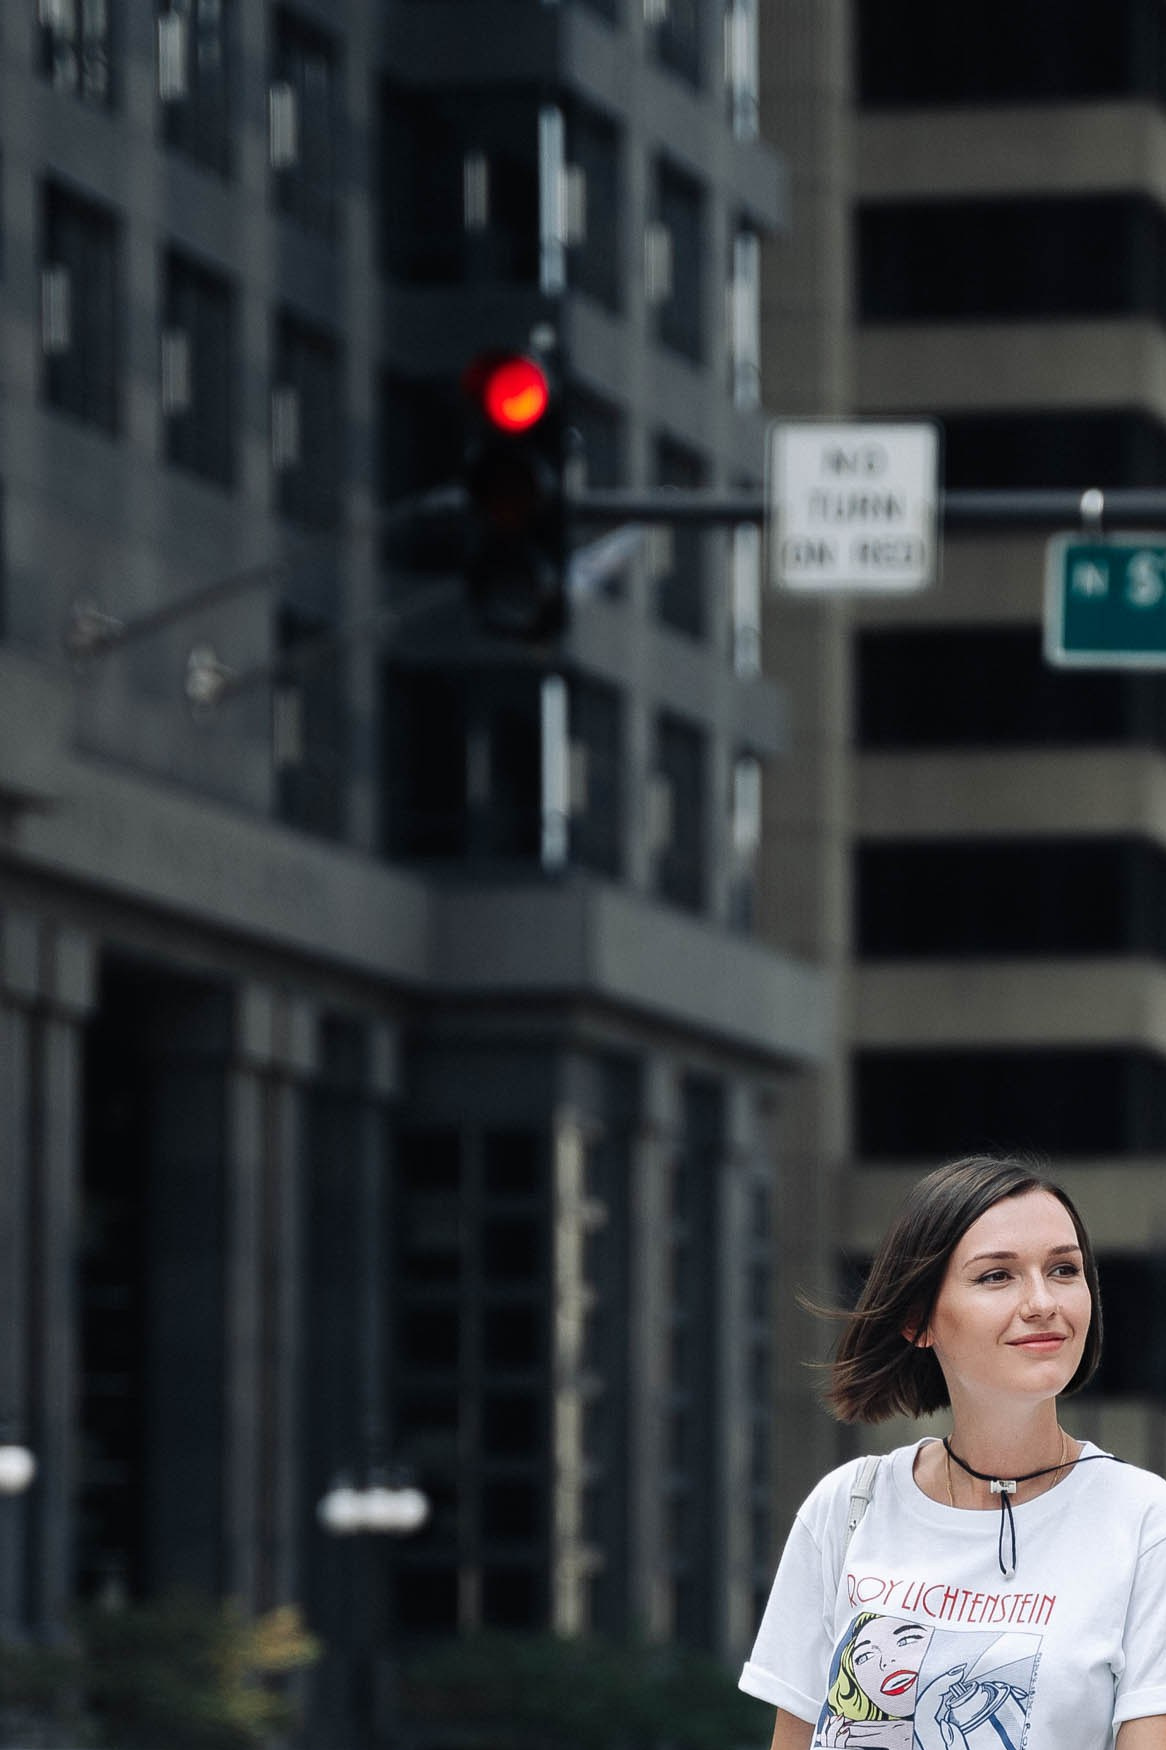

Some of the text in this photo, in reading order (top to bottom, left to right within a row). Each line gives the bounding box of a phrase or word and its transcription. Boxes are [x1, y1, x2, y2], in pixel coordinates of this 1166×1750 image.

[822, 443, 889, 478] NO
[808, 485, 906, 521] TURN
[781, 533, 926, 571] ON RED
[1072, 560, 1109, 598] N
[847, 1574, 1056, 1625] ROY LICHTENSTEIN
